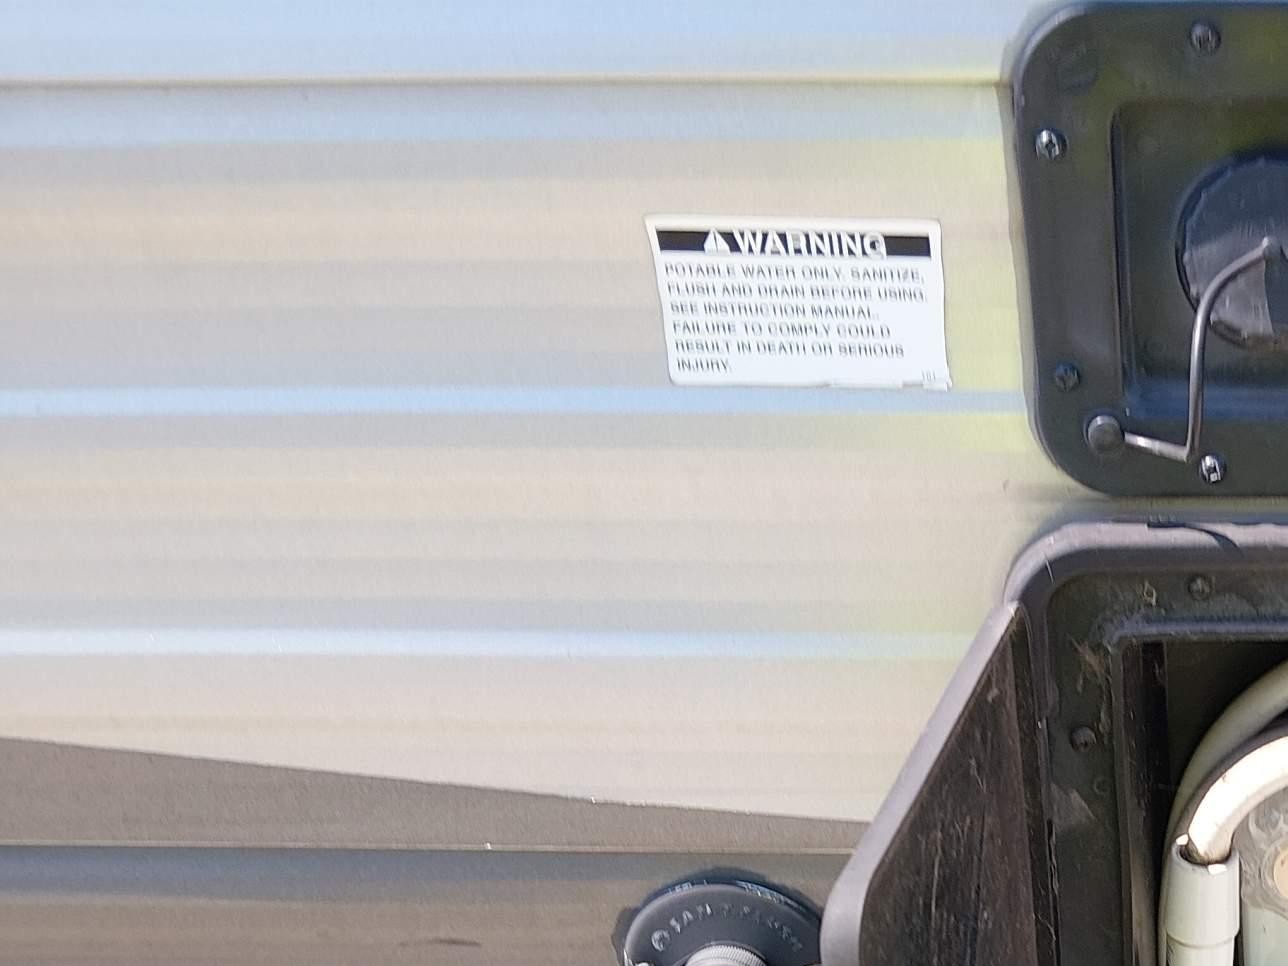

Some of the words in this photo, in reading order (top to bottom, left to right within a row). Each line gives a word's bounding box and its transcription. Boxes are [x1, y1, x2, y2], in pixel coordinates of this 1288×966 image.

[733, 229, 887, 259] WARNING
[664, 261, 735, 278] POTABLE
[741, 263, 796, 280] WATER
[667, 281, 717, 297] FLUSH
[721, 283, 753, 298] AND
[758, 285, 806, 299] DRAIN
[810, 285, 872, 300] BEFORE
[671, 301, 698, 314] SEE
[703, 302, 806, 317] INSTRUCTION
[673, 320, 736, 334] FAILURE
[743, 322, 763, 336] TO
[767, 322, 831, 338] COMPLY
[836, 324, 891, 338] COULD
[675, 340, 731, 354] RESULT
[736, 341, 752, 354] IN
[756, 342, 806, 355] DEATH
[811, 343, 834, 356] OR
[839, 343, 905, 358] SERIOUS
